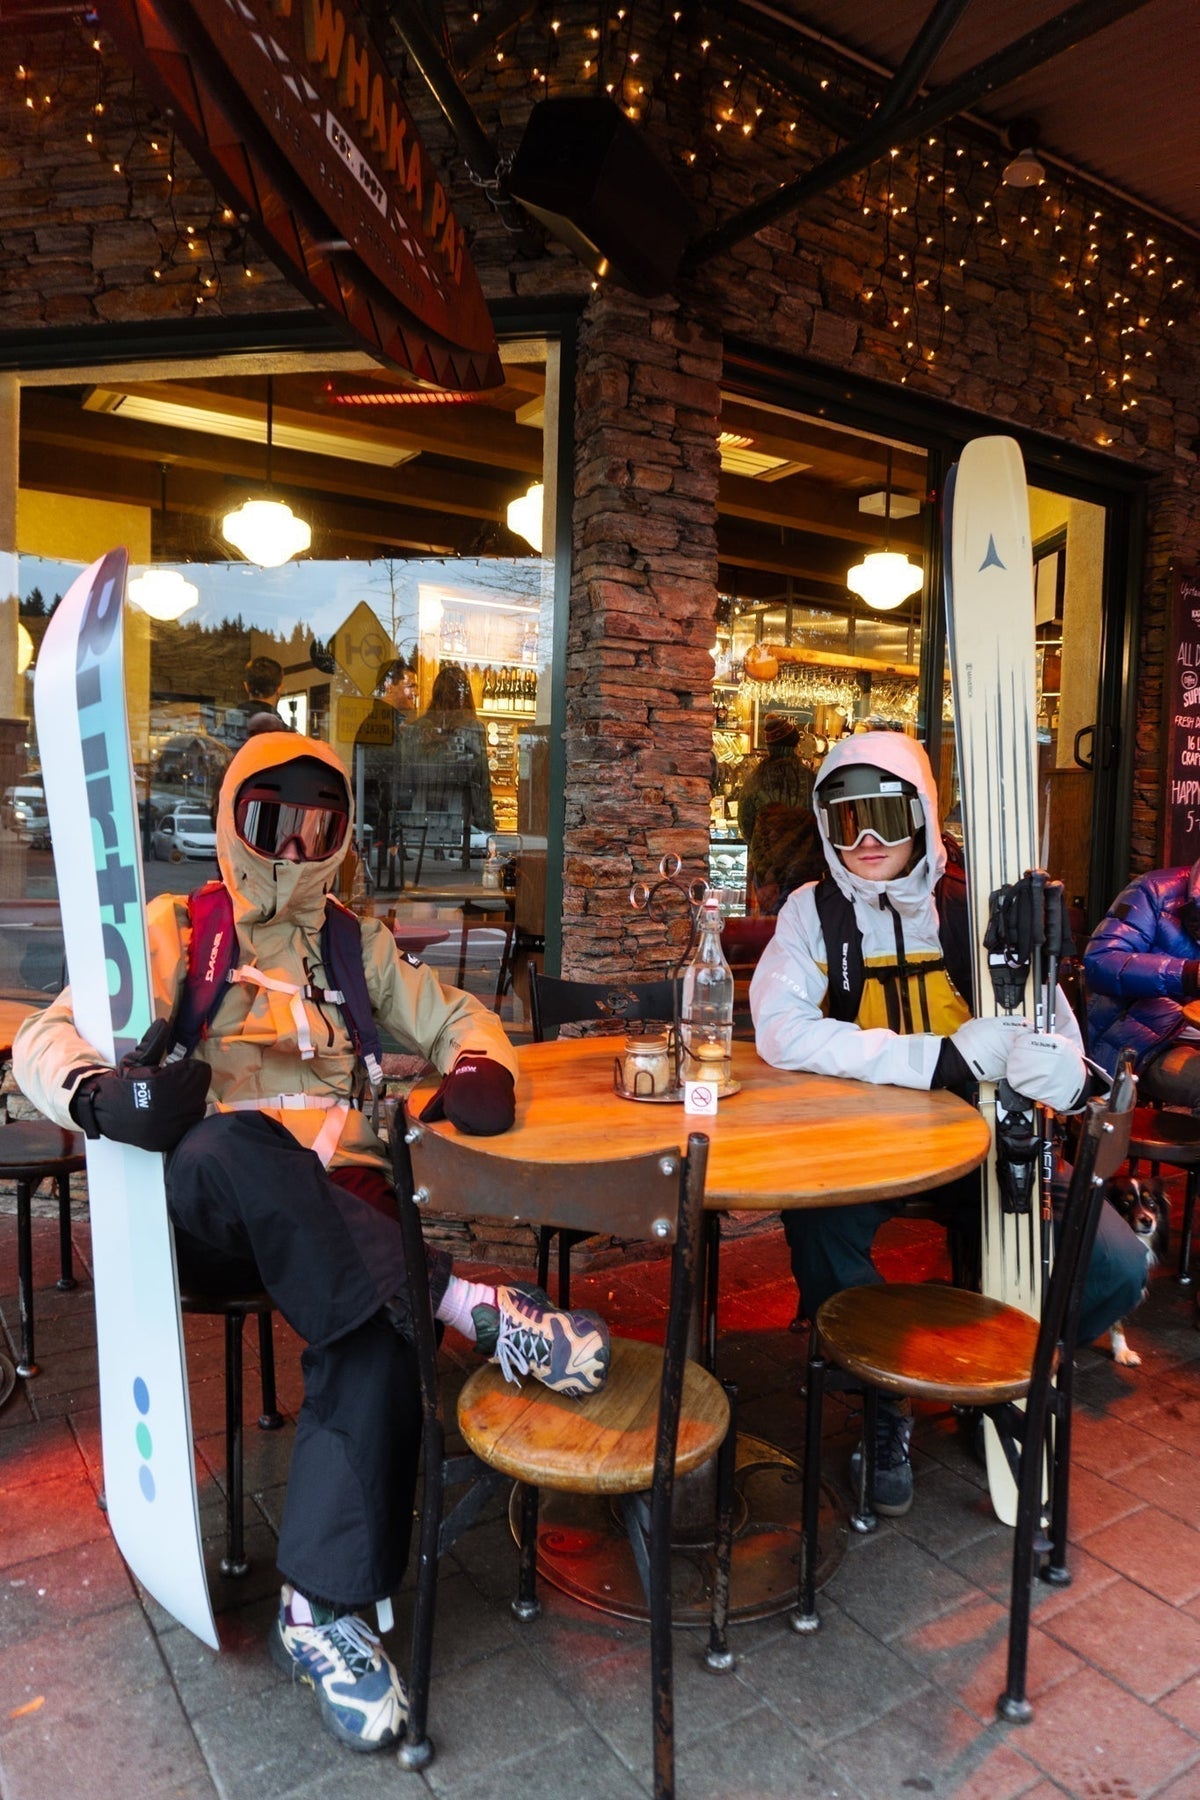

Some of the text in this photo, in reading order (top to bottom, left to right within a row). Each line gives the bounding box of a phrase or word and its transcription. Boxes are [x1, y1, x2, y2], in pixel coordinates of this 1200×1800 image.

[205, 930, 223, 984] DAKINE
[841, 942, 851, 992] DAKINE
[136, 1082, 149, 1108] POW
